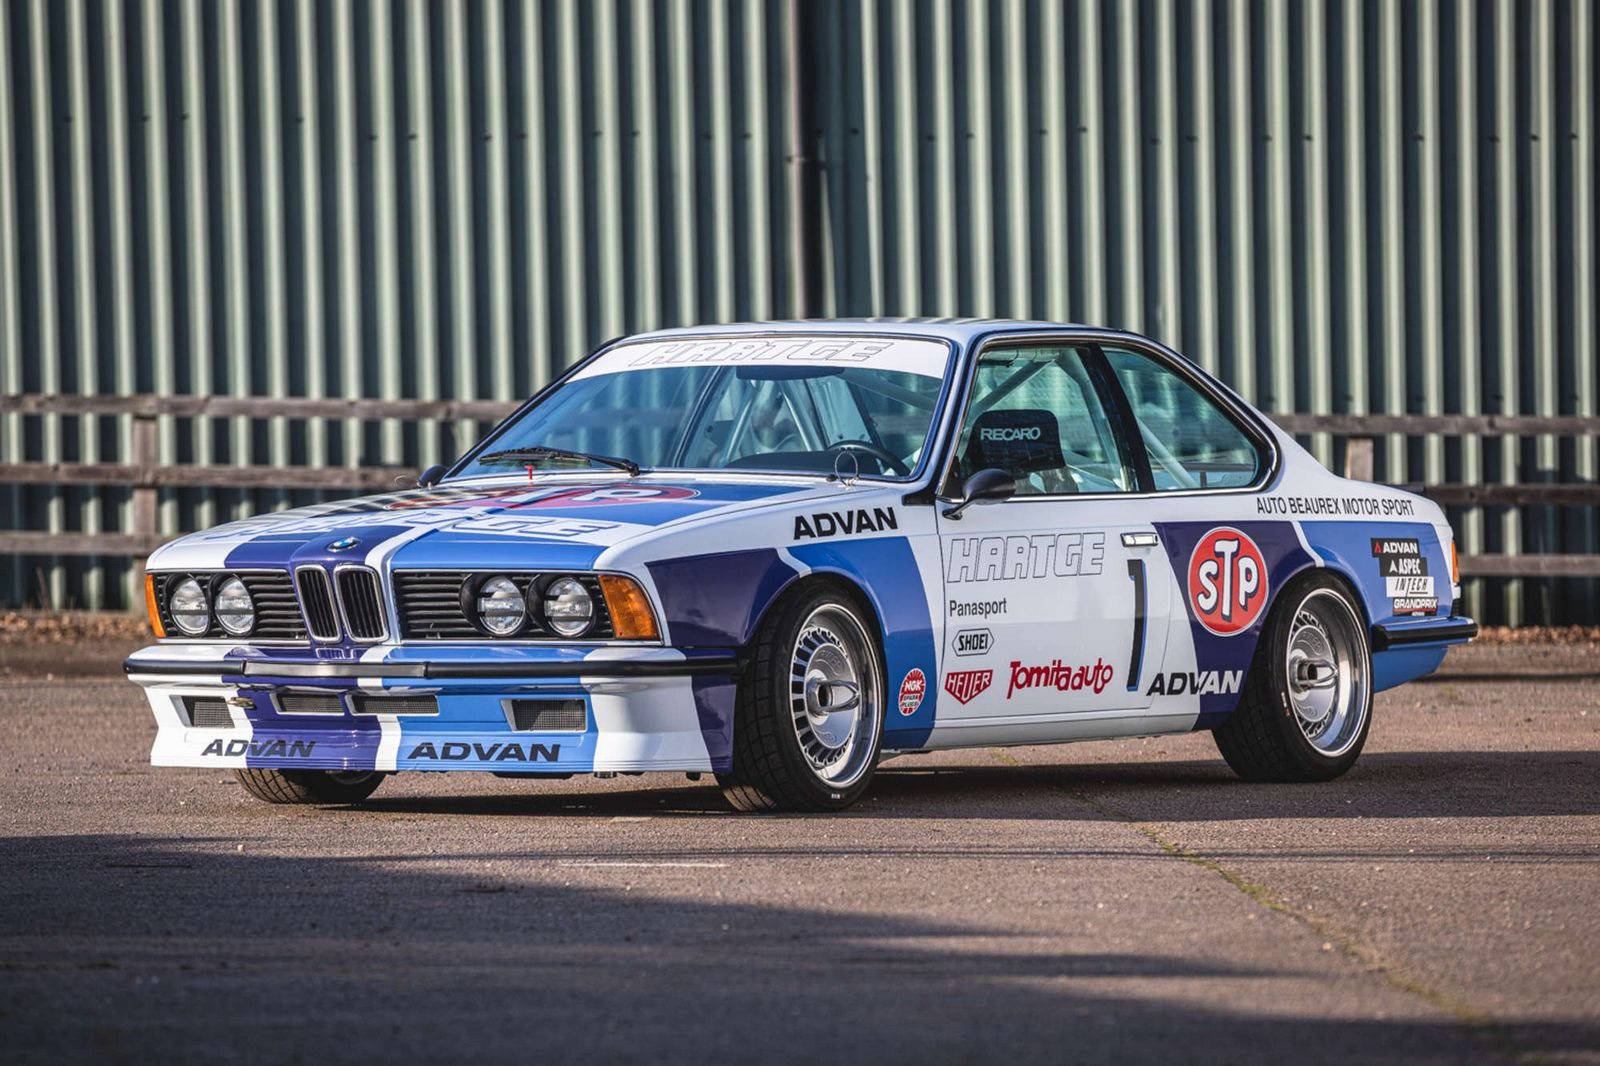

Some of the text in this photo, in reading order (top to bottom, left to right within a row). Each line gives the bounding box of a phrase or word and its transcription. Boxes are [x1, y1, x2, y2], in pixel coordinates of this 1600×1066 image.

[628, 340, 894, 367] HARTGE
[980, 427, 1041, 440] RECARO
[1256, 497, 1415, 516] AUTO BEAUREX MOTOR SPORT
[793, 507, 898, 540] ADVAN
[947, 532, 1105, 583] HARTGE
[1383, 542, 1418, 553] ADVAN
[1398, 558, 1421, 575] ASPEC
[1197, 538, 1260, 622] STP
[1395, 577, 1428, 597] INTECH
[949, 598, 1007, 619] Panasport
[1126, 558, 1148, 692] 1
[958, 633, 988, 651] SHOEI
[904, 679, 923, 691] NGK
[946, 671, 991, 700] HEUER
[1146, 670, 1243, 696] ADVAN
[201, 738, 316, 757] ADVAN
[408, 742, 561, 762] ADVAN
